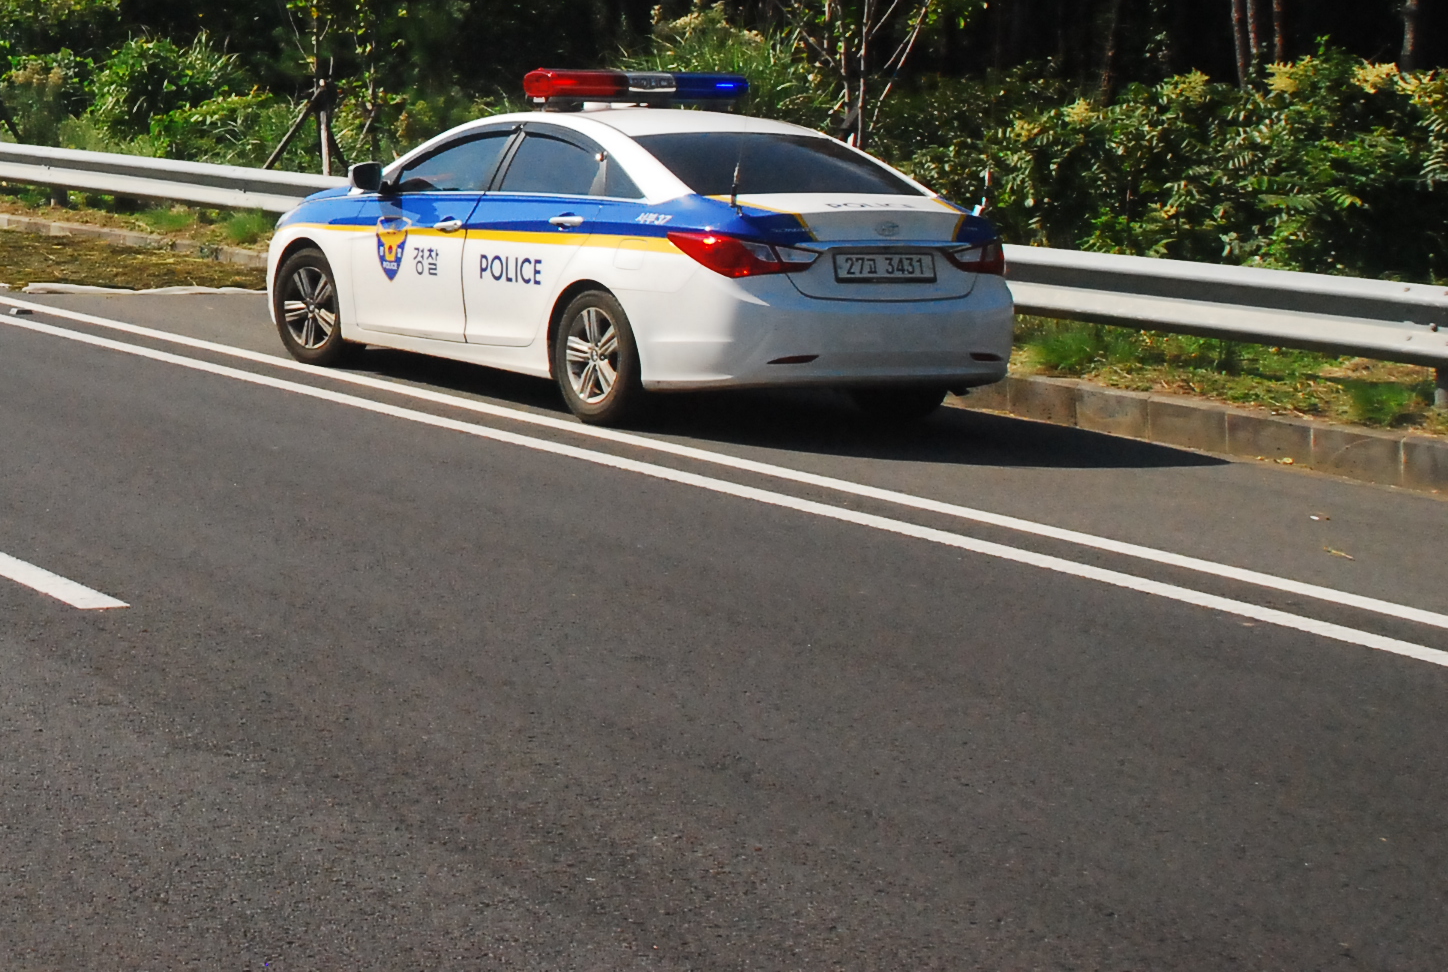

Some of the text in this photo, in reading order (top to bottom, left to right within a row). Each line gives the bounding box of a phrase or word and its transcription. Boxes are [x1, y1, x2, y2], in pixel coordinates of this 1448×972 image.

[413, 246, 439, 276] 경찰
[479, 253, 542, 285] POLICE
[845, 257, 924, 275] 27고 3431
